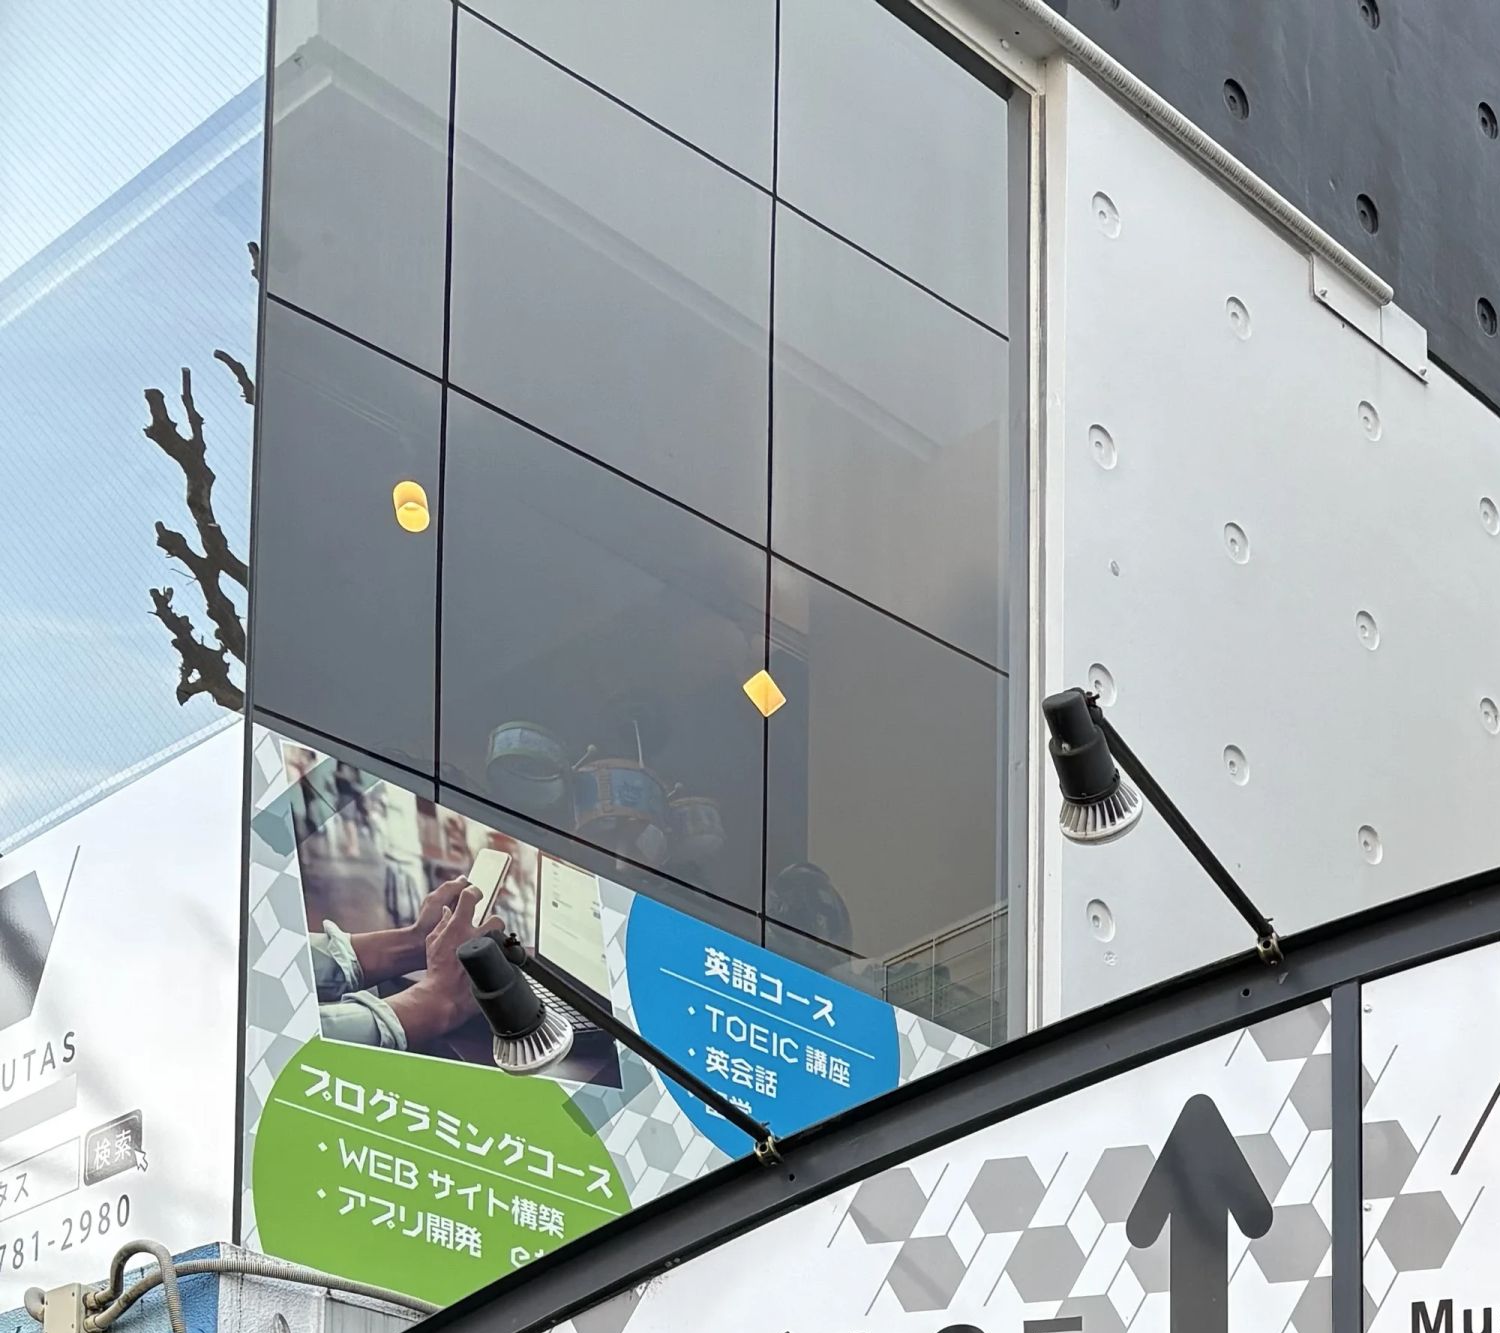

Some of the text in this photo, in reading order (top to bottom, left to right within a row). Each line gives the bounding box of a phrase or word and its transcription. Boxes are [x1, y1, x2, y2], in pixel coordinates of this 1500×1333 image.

[704, 946, 836, 1027] 英語コース
[705, 1004, 851, 1089] TOEIC 講座
[705, 1046, 778, 1099] 英会話
[94, 1129, 133, 1170] 検索
[300, 1064, 614, 1199] プログラミングコース
[338, 1138, 565, 1239] WEB サイト構築
[338, 1186, 483, 1259] アプリ開発
